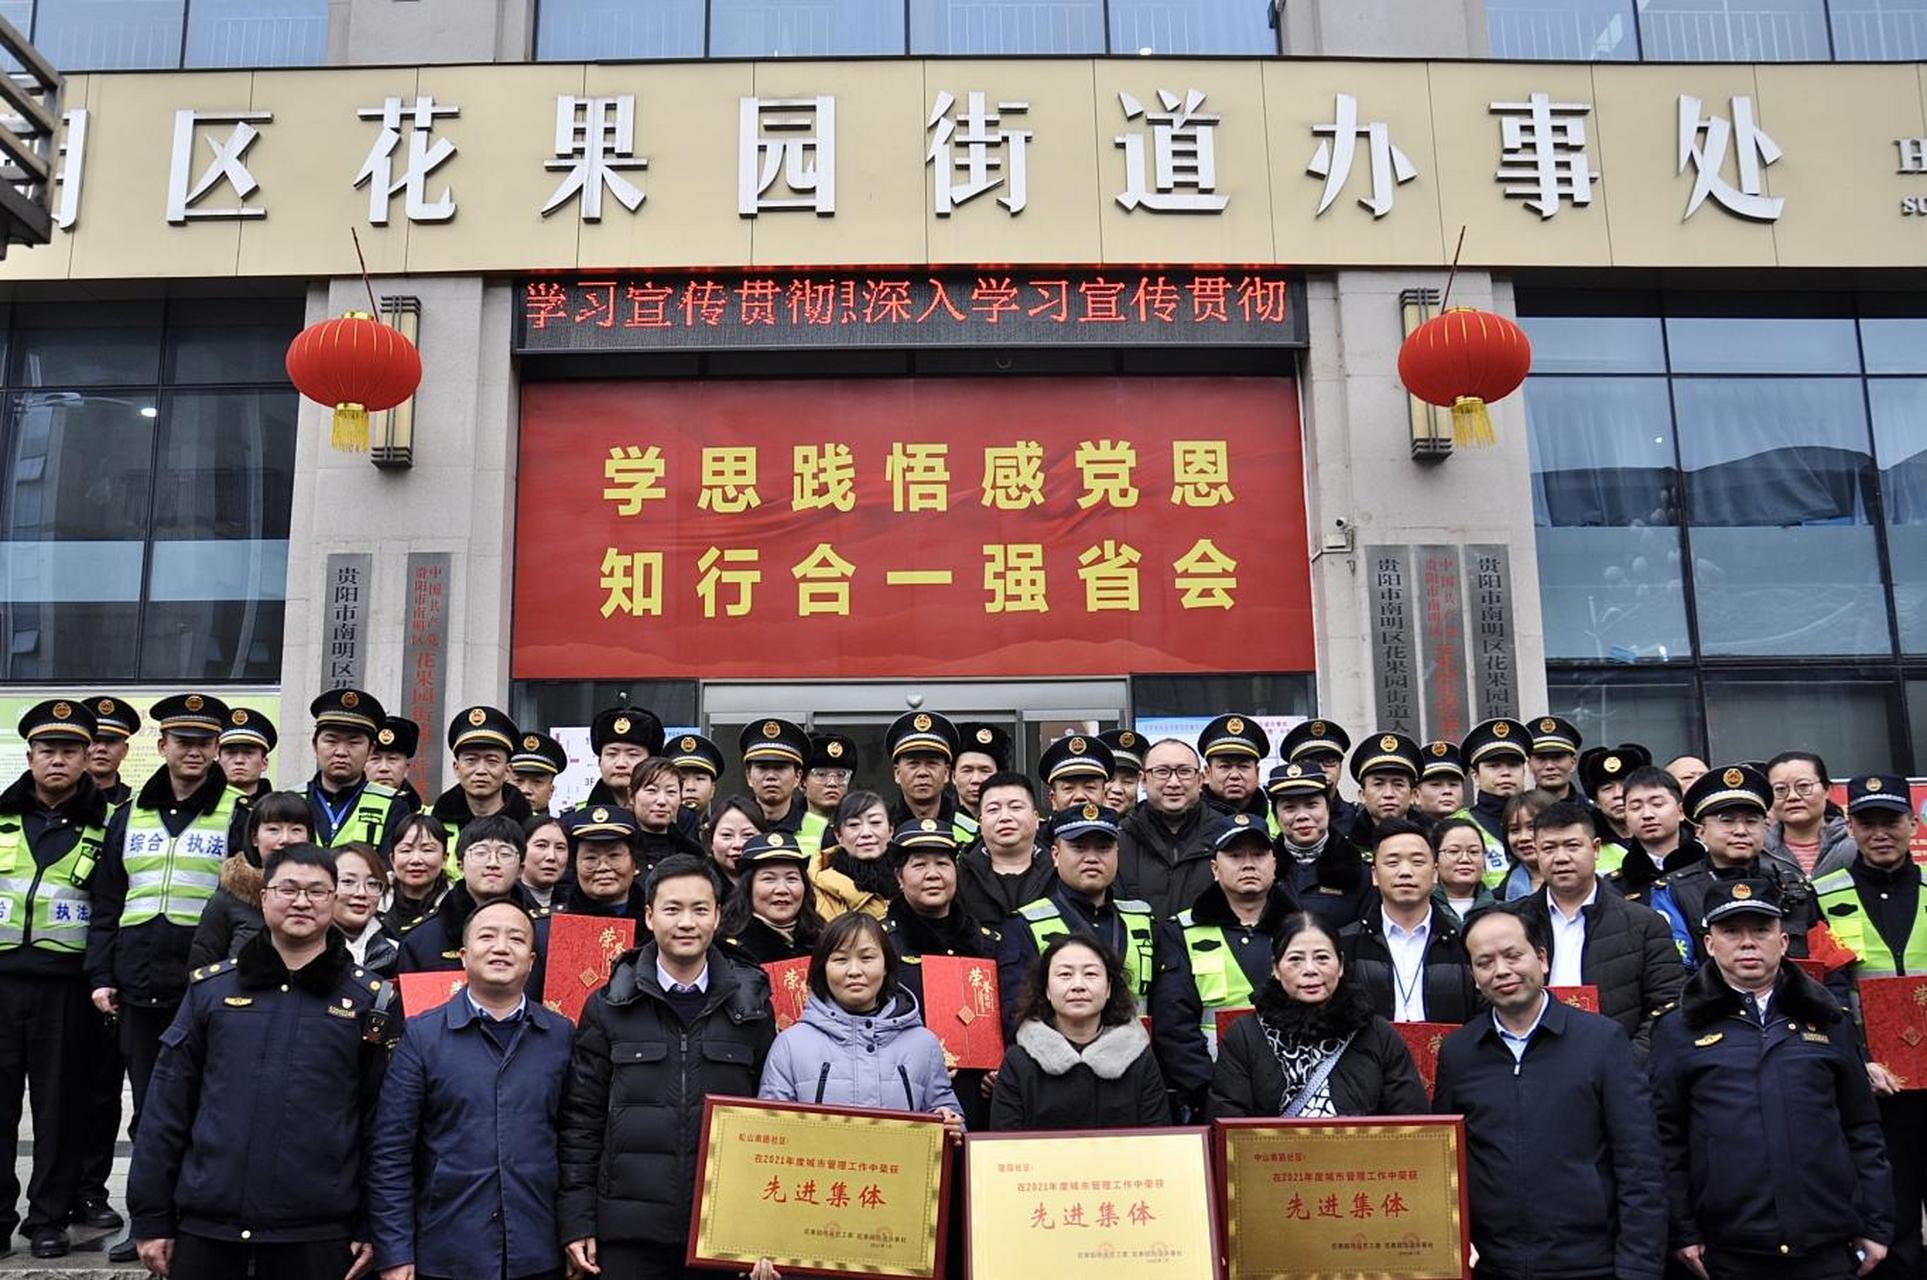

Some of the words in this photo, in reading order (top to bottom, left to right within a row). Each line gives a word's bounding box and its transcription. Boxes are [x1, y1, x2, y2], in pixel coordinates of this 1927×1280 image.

[2, 93, 1785, 231] 区花果园街道办事处
[602, 439, 1235, 517] 学思践悟感党恩
[599, 538, 1239, 619] 知行合一强省会
[129, 833, 165, 853] 综合
[187, 834, 225, 856] 执法
[55, 903, 91, 922] 执法
[762, 1175, 887, 1210] 先进集体
[1286, 1191, 1410, 1220] 先进集体
[1030, 1200, 1157, 1230] 先进集体
